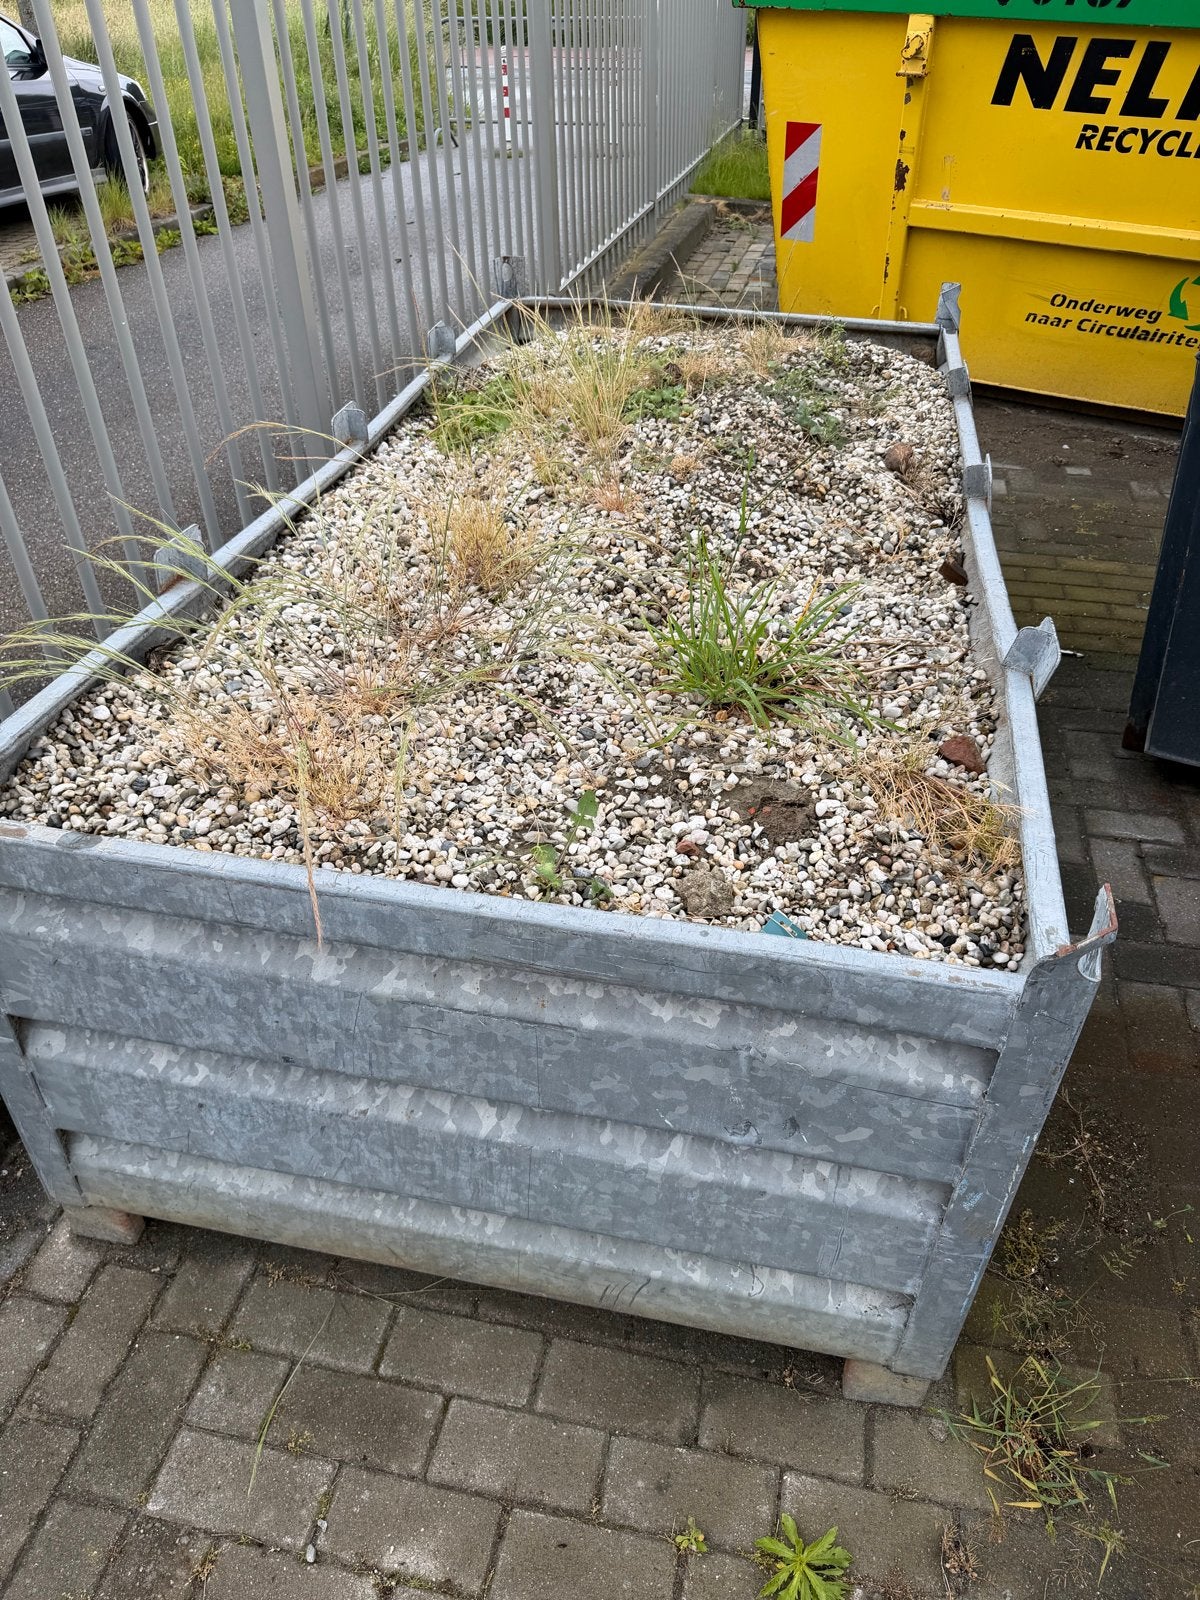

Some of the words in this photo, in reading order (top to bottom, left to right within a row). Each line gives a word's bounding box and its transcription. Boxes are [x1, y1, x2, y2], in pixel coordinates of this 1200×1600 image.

[1050, 293, 1163, 324] Onderweg
[1025, 312, 1072, 328] naar
[1076, 318, 1200, 348] Circulairite
